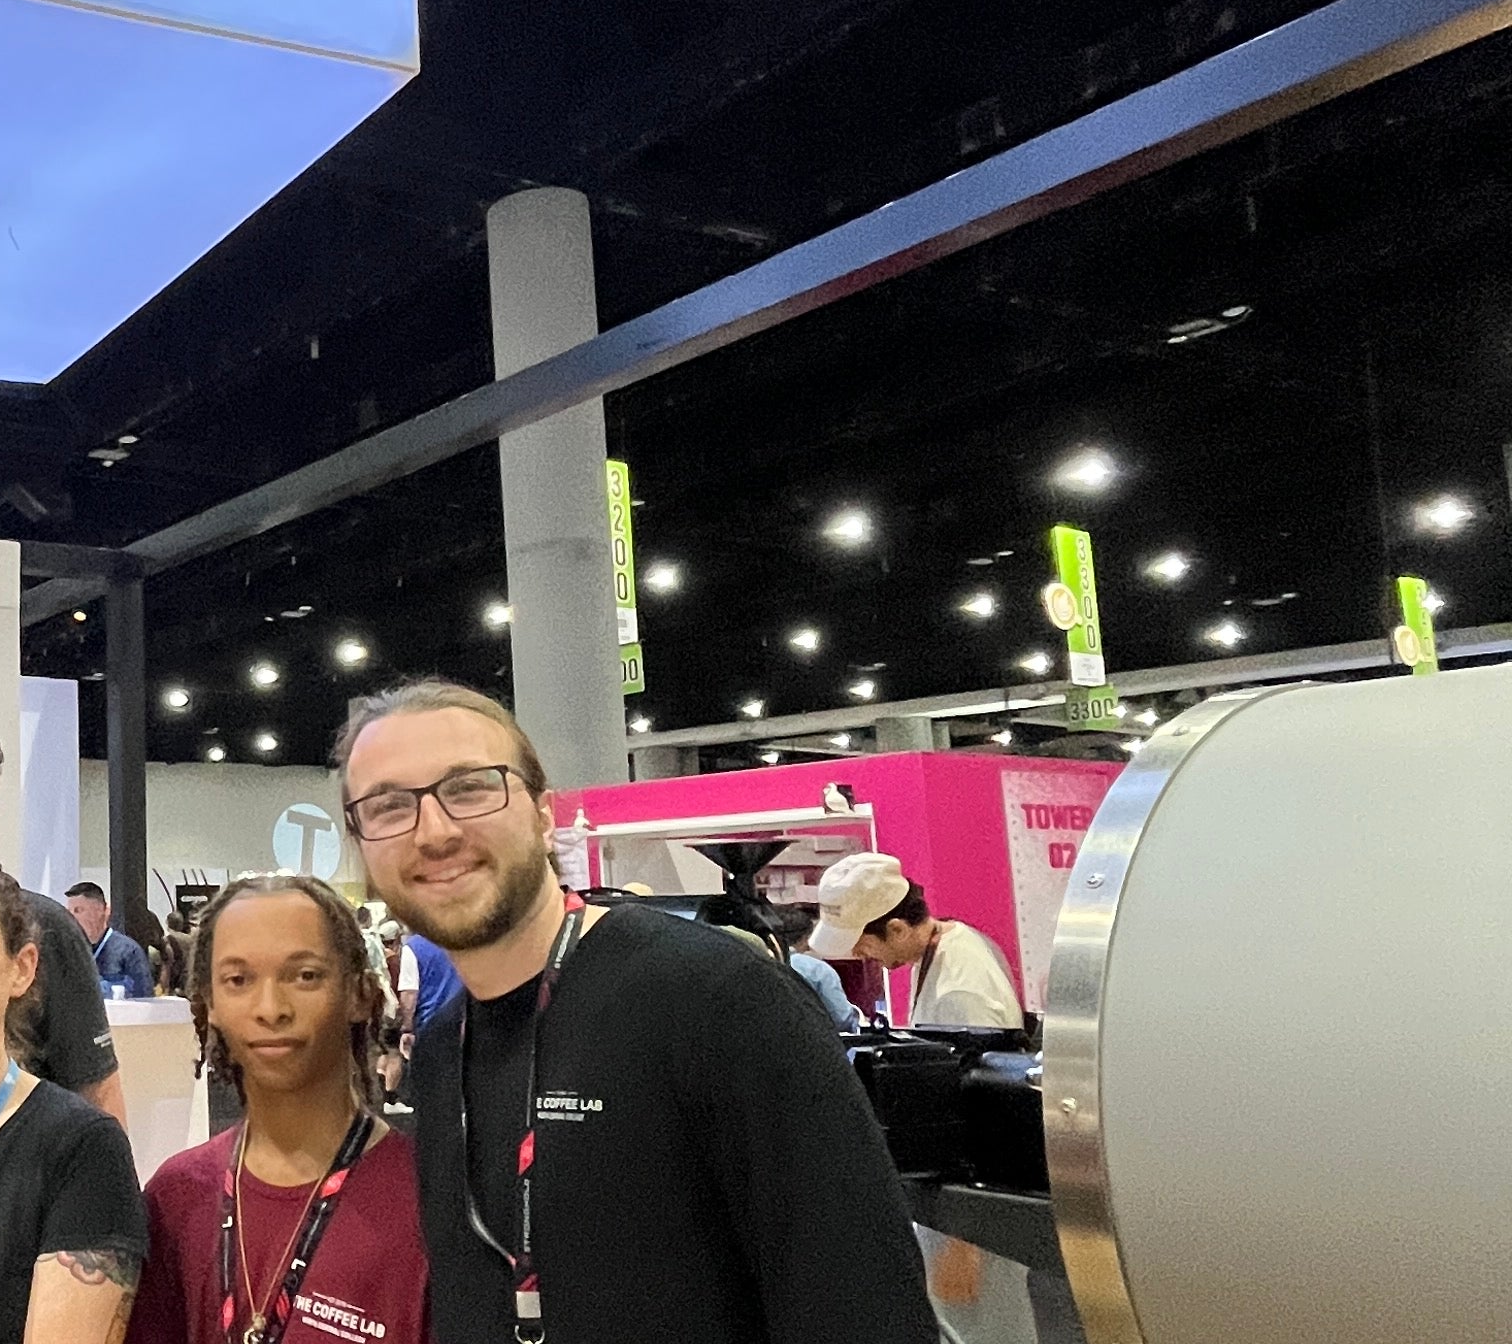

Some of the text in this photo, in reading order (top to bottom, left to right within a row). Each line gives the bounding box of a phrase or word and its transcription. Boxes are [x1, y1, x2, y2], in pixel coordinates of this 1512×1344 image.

[610, 469, 629, 601] 3200
[1077, 537, 1097, 650] 3300
[543, 1097, 578, 1110] COFFEE
[580, 1099, 603, 1111] LAB
[312, 1301, 359, 1330] COFFEE
[359, 1318, 386, 1339] LAB
